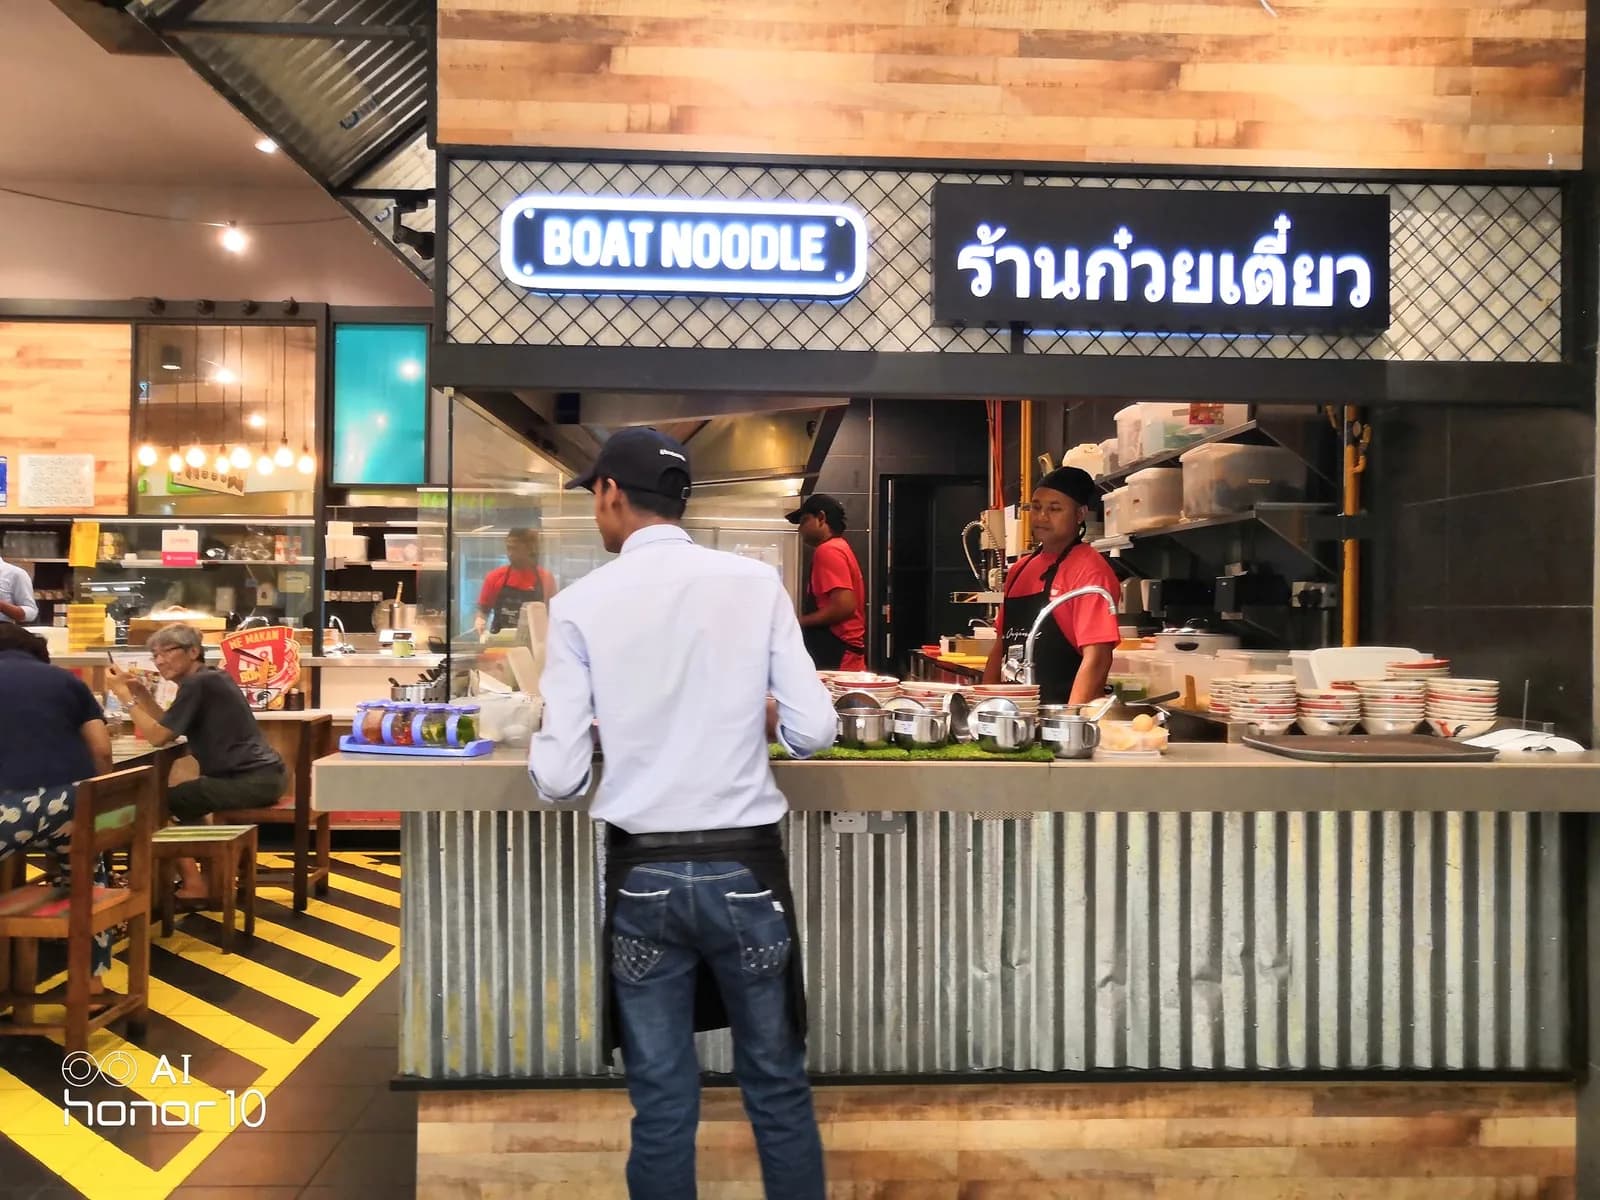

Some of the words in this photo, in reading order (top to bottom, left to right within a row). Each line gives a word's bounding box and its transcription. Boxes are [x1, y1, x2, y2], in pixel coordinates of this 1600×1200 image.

[542, 217, 655, 267] BOAT
[660, 221, 826, 272] NOODLE
[956, 213, 1372, 308] ร้านก๋วยเตี๋ยว
[244, 629, 280, 645] MAKAN
